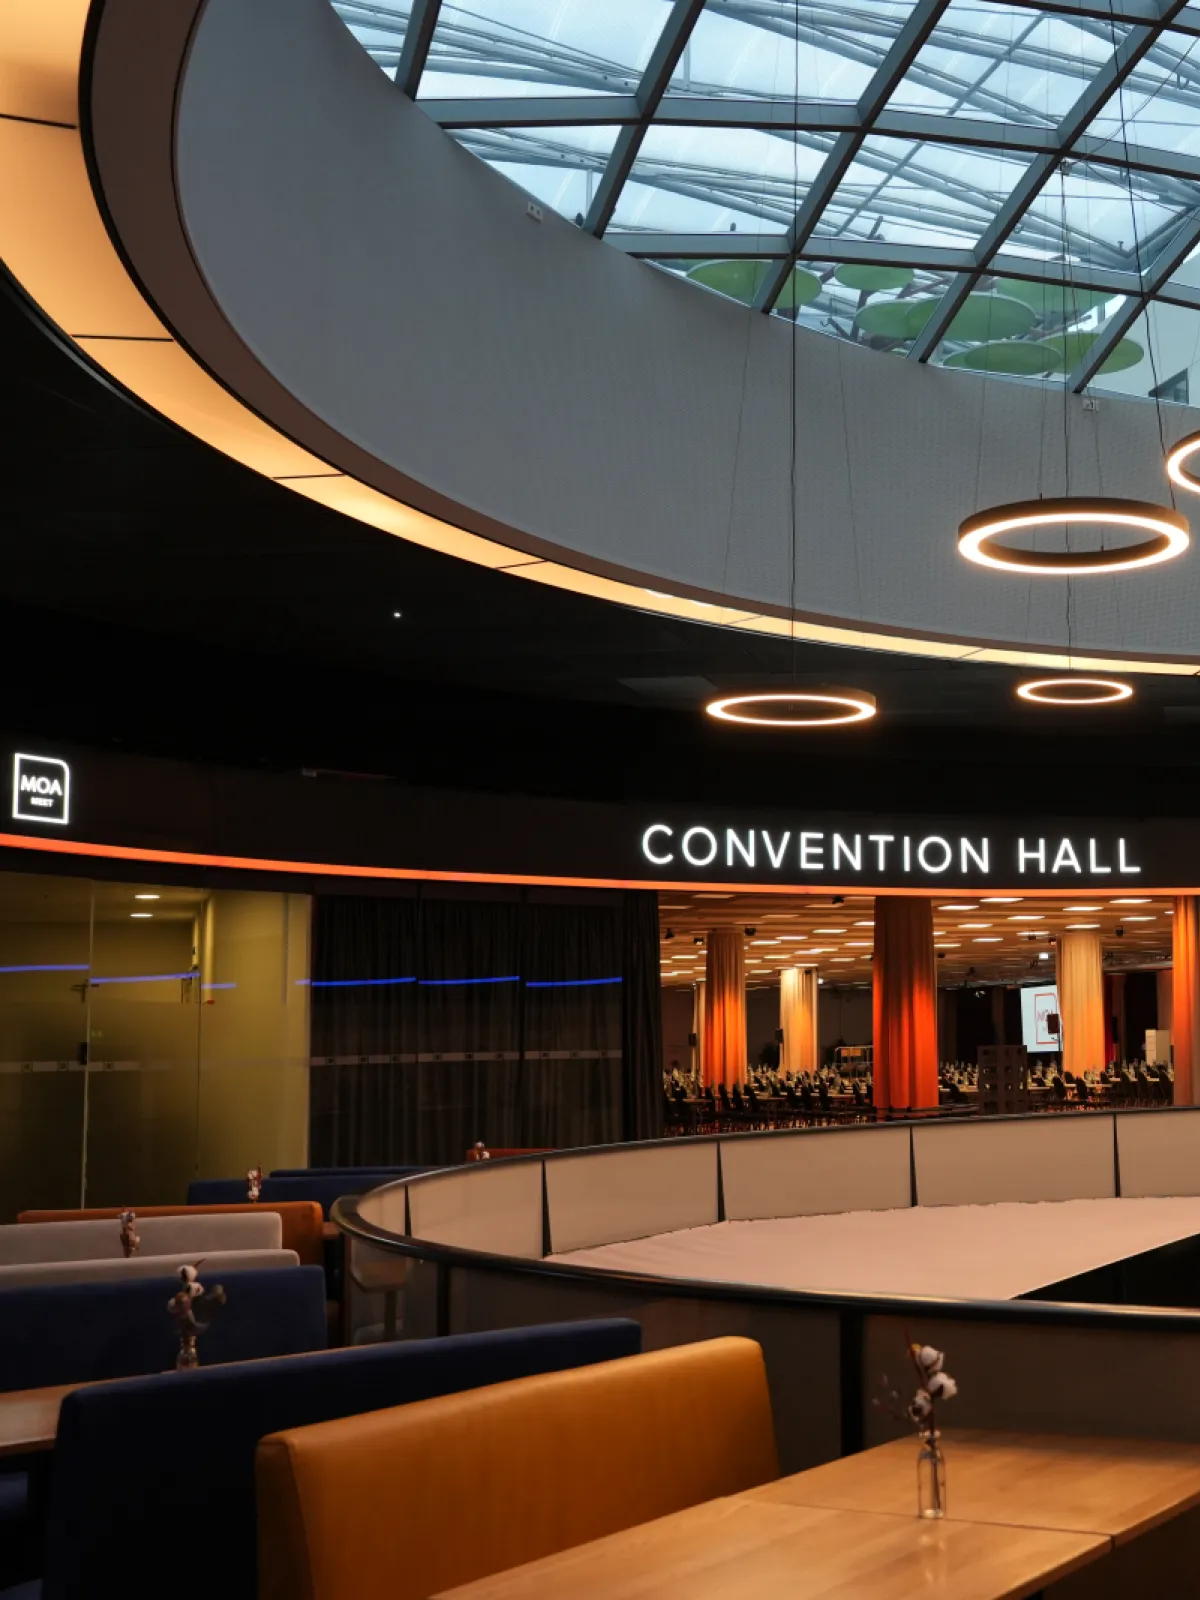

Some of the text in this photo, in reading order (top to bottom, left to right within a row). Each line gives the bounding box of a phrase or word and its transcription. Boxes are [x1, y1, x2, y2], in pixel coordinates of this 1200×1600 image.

[20, 774, 63, 796] MOA
[641, 823, 1142, 875] CONVENTION HALL
